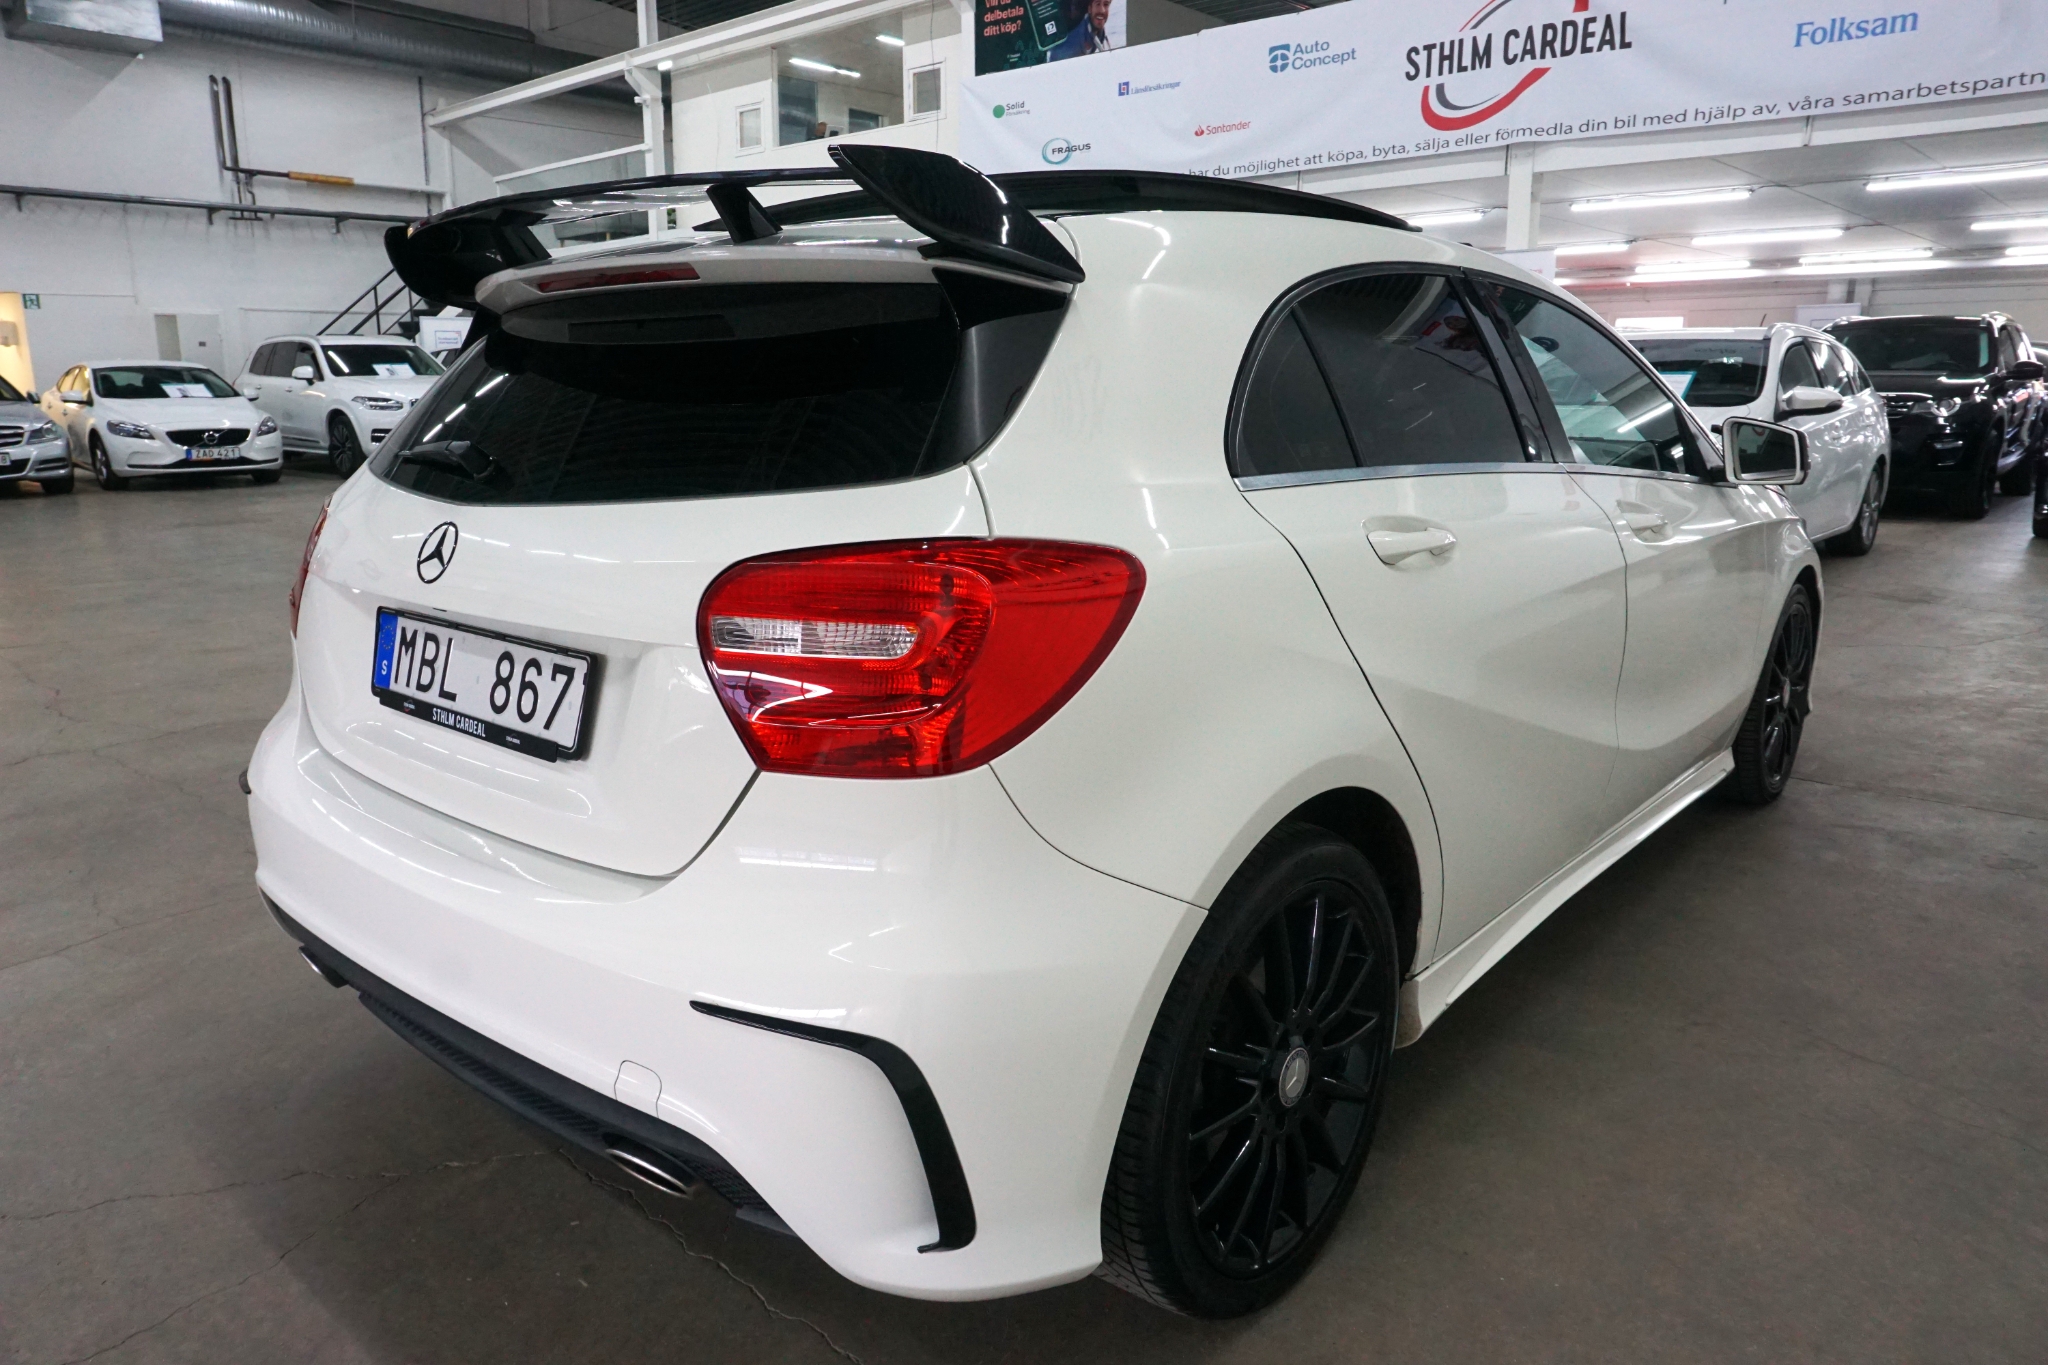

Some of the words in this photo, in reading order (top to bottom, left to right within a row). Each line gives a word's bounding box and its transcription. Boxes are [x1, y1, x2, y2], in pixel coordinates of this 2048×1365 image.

[984, 6, 1024, 22] delbetala
[983, 25, 1000, 36] ditt
[1000, 19, 1022, 34] köp?
[1793, 12, 1919, 48] Folksam
[1292, 40, 1330, 57] Auto
[1405, 32, 1493, 82] STHLM
[1502, 11, 1633, 66] CARDEAL
[1291, 47, 1357, 70] Concept
[1005, 101, 1025, 111] Solid
[1206, 121, 1251, 135] Santander
[1212, 165, 1230, 177] du
[1234, 156, 1300, 175] möjlighet
[1303, 154, 1323, 166] att
[1327, 149, 1368, 163] köpa,
[1372, 144, 1410, 159] byta,
[1414, 138, 1450, 152] sälja
[1454, 133, 1491, 147] eller
[1494, 122, 1573, 141] förmedla
[1578, 119, 1608, 133] din
[1613, 114, 1637, 130] bil
[1642, 109, 1688, 127] med
[1693, 104, 1746, 124] hjälp
[1751, 103, 1781, 116] av,
[1787, 95, 1835, 112] våra
[1842, 72, 2046, 107] samarbetspartn
[1051, 143, 1092, 155] FRAGUS
[195, 449, 214, 459] ZAD
[217, 448, 235, 458] 421
[381, 659, 389, 676] S
[394, 626, 458, 703] MBL
[489, 650, 577, 731] 867
[432, 707, 455, 727] STHLM
[455, 714, 487, 738] CARDEAL
